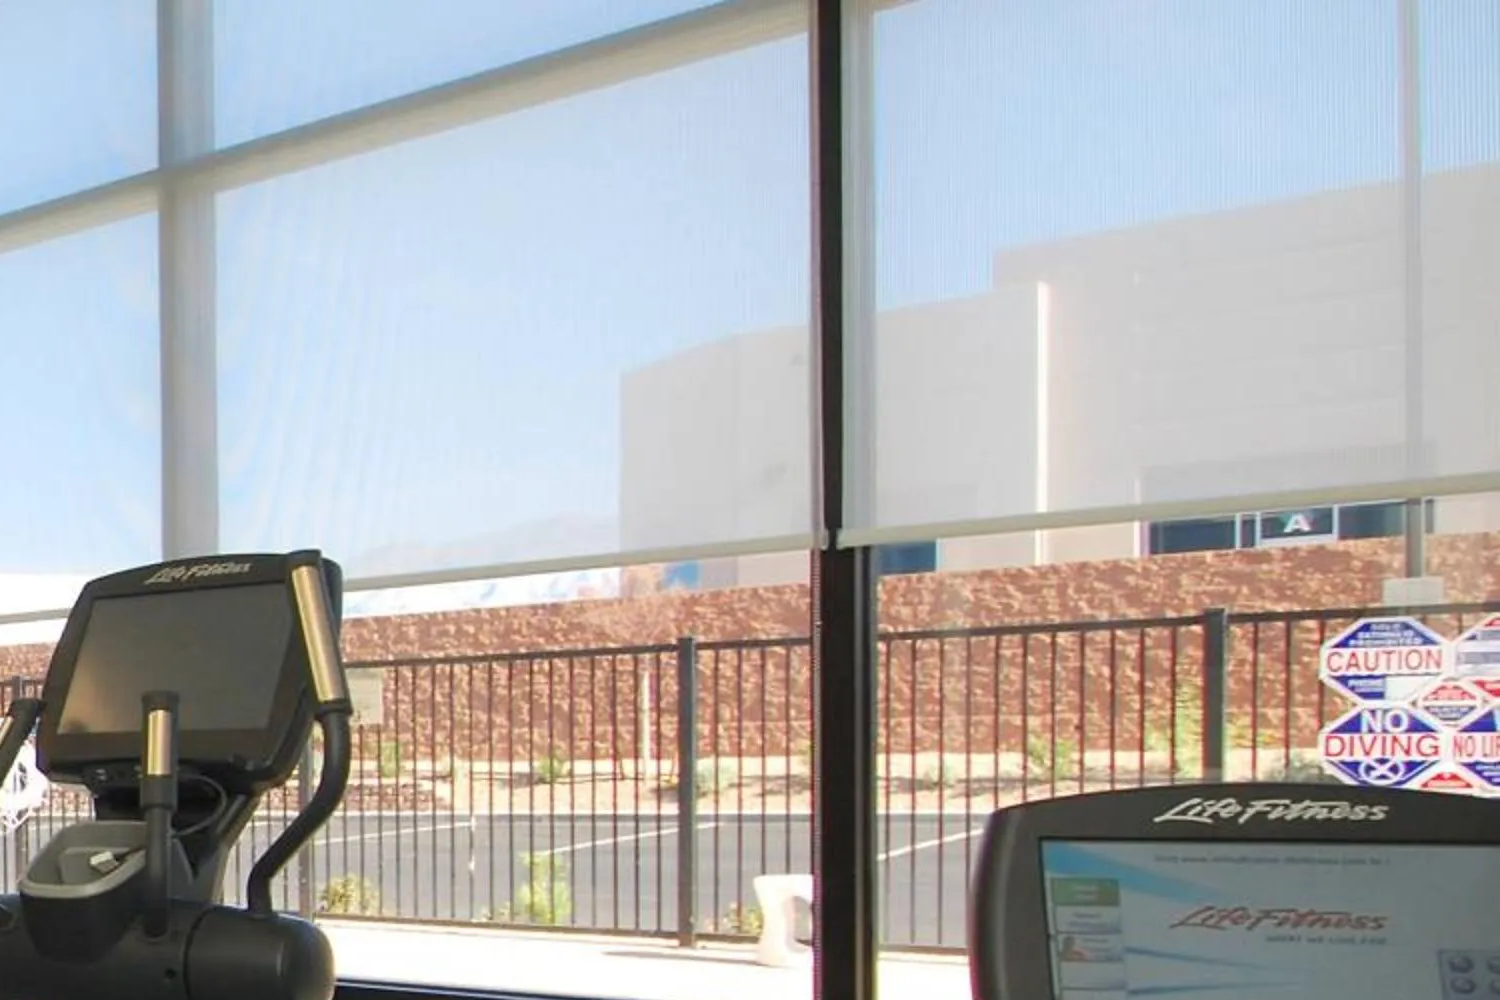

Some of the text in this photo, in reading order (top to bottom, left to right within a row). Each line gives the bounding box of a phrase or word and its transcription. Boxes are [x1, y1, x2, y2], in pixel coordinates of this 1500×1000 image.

[1326, 649, 1442, 673] CAUTION
[1360, 708, 1409, 733] NO
[1324, 734, 1440, 758] DIVING
[1453, 735, 1476, 757] NO
[1238, 799, 1390, 824] Fitness
